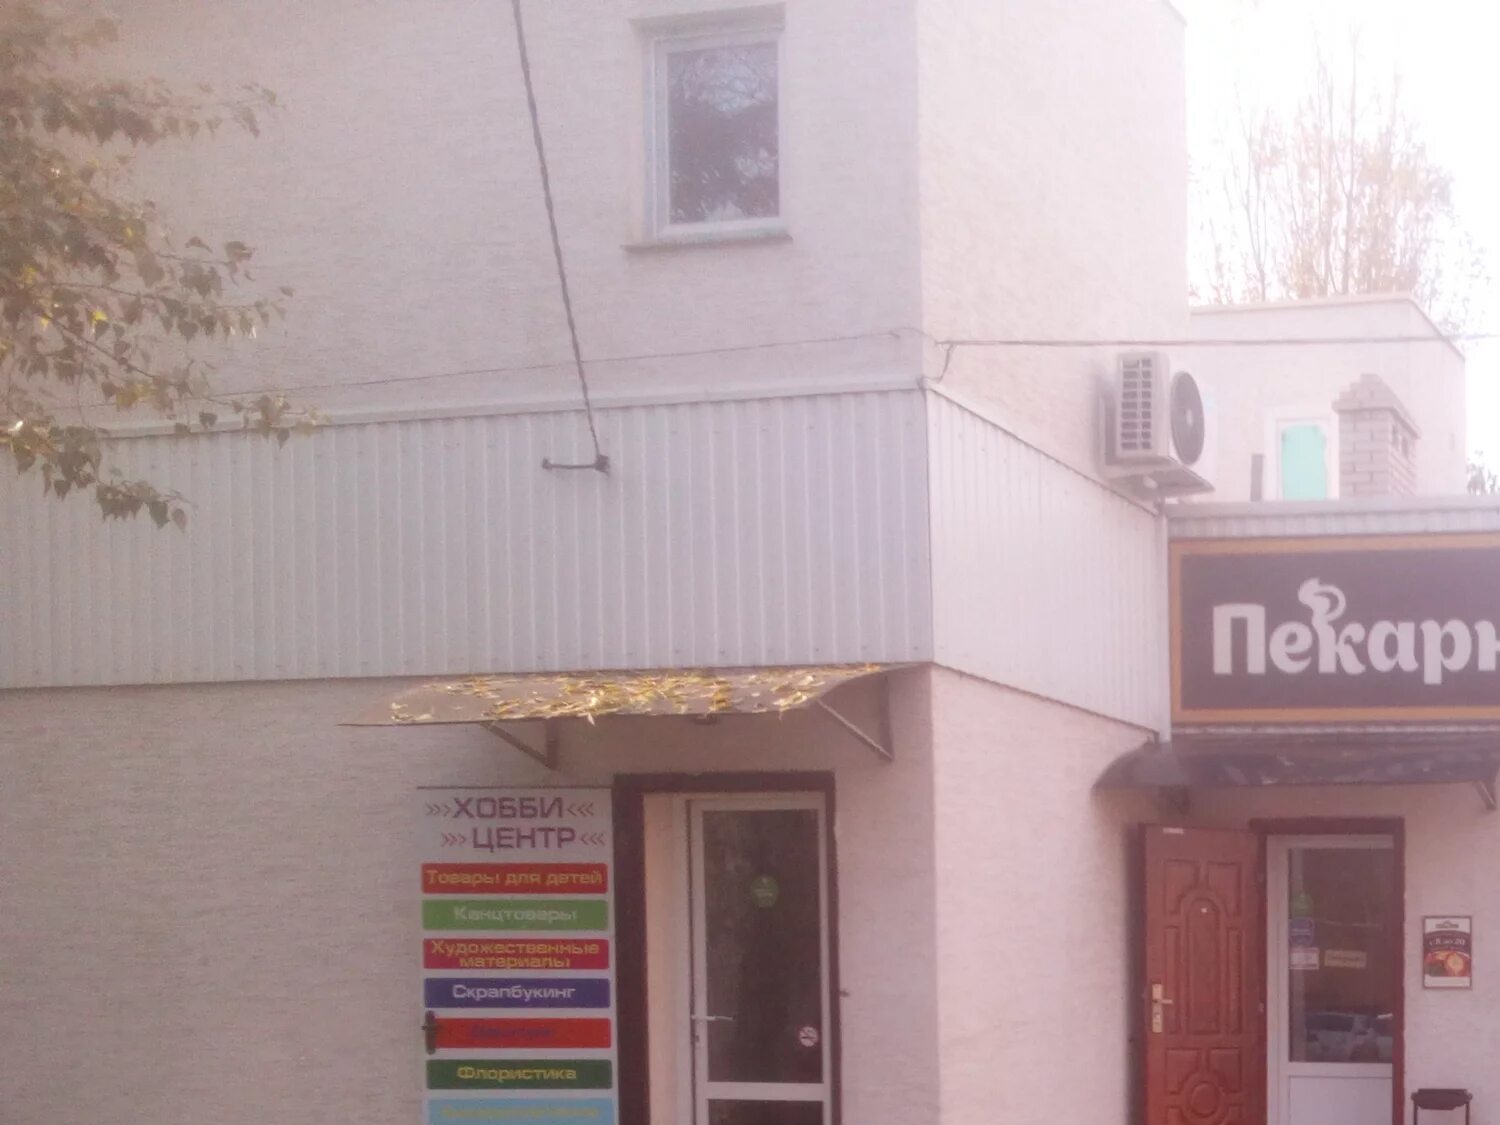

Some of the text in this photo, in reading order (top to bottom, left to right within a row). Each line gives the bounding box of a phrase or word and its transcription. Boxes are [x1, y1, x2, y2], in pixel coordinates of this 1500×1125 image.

[453, 796, 563, 819] ХОББИ
[472, 827, 576, 853] ЦЕНТР
[426, 869, 602, 887] Товары для детей
[453, 906, 578, 923] Канцтовары
[431, 940, 599, 957] Художественные
[459, 956, 570, 970] материалы
[452, 984, 576, 1001] Скрапбукинг
[456, 1066, 577, 1083] Флористика
